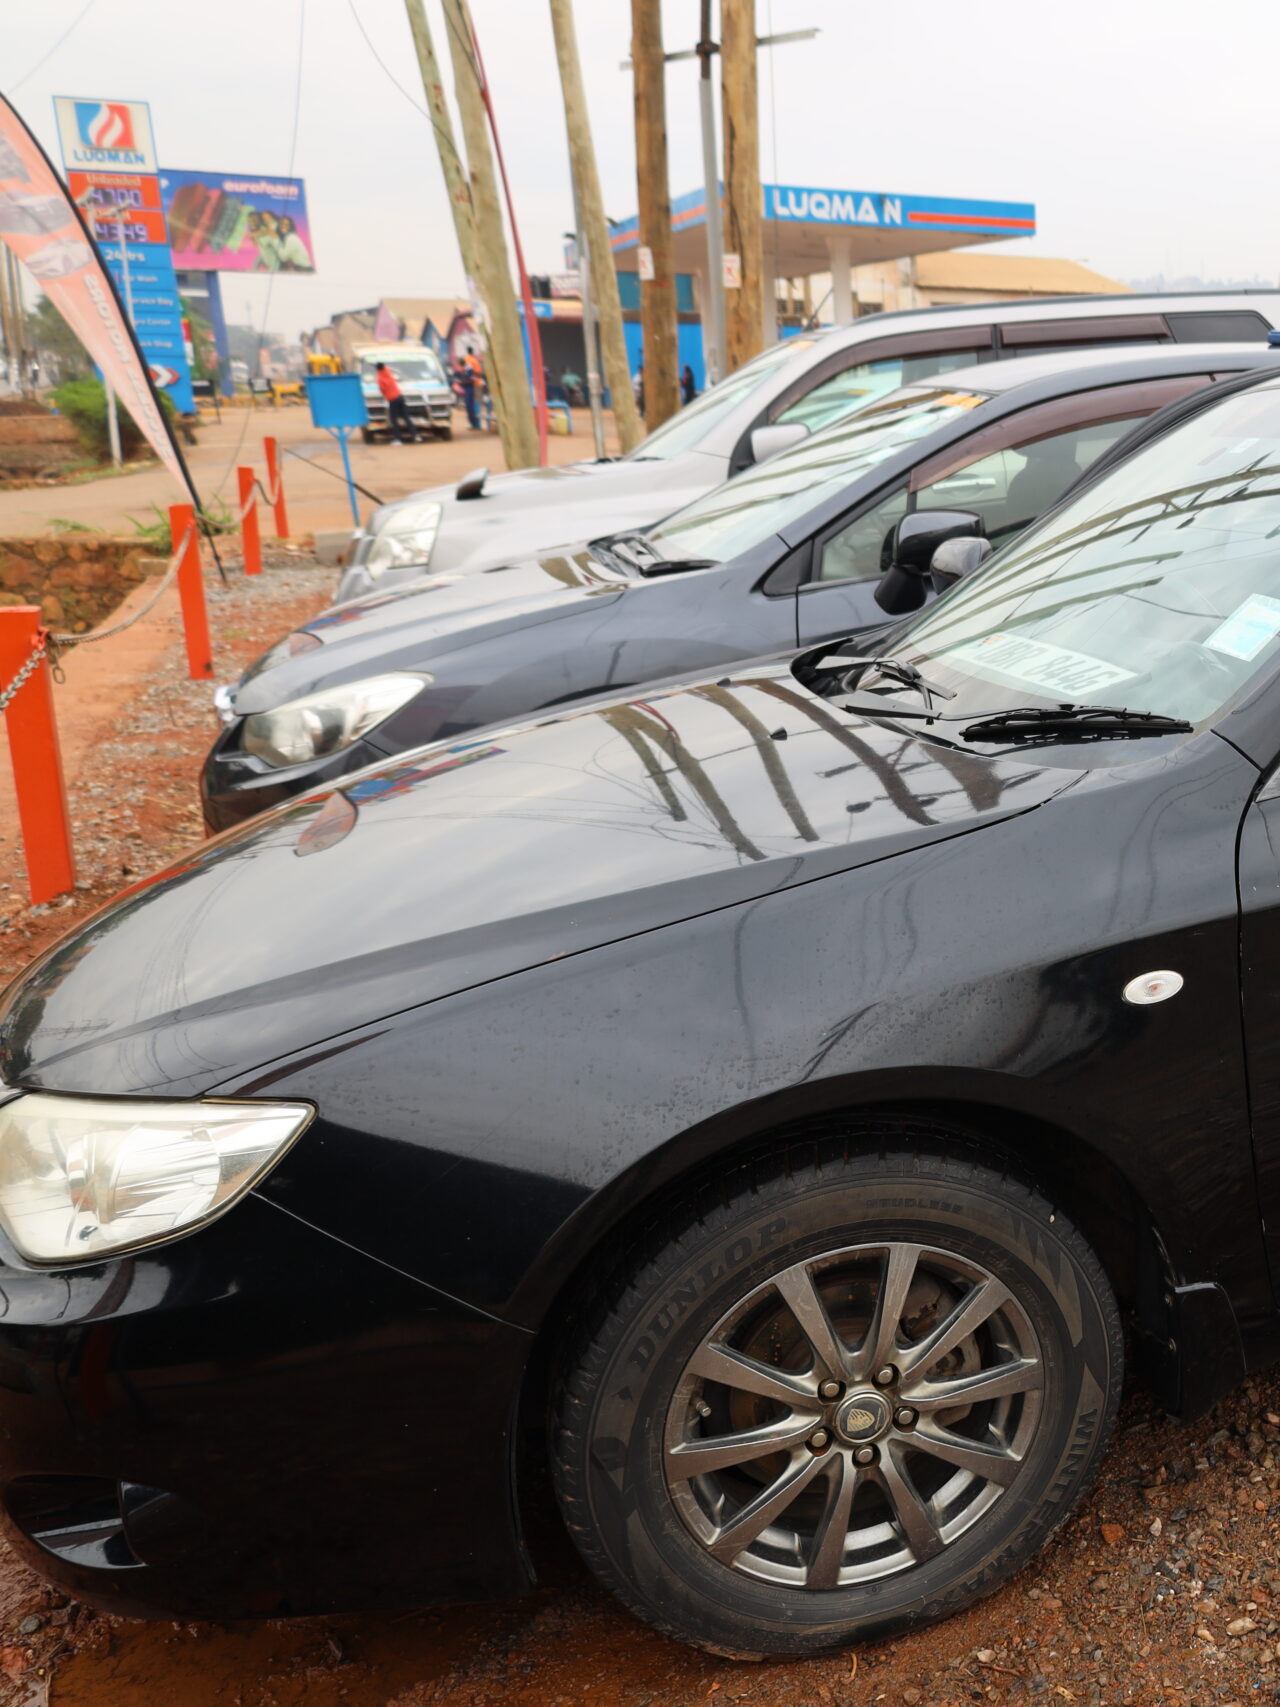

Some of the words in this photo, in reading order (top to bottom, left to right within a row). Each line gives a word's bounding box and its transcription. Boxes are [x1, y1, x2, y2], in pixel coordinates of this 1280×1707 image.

[73, 149, 146, 164] LUQMAN
[772, 188, 902, 225] LUQMAN
[629, 1216, 786, 1373] DUNLOP
